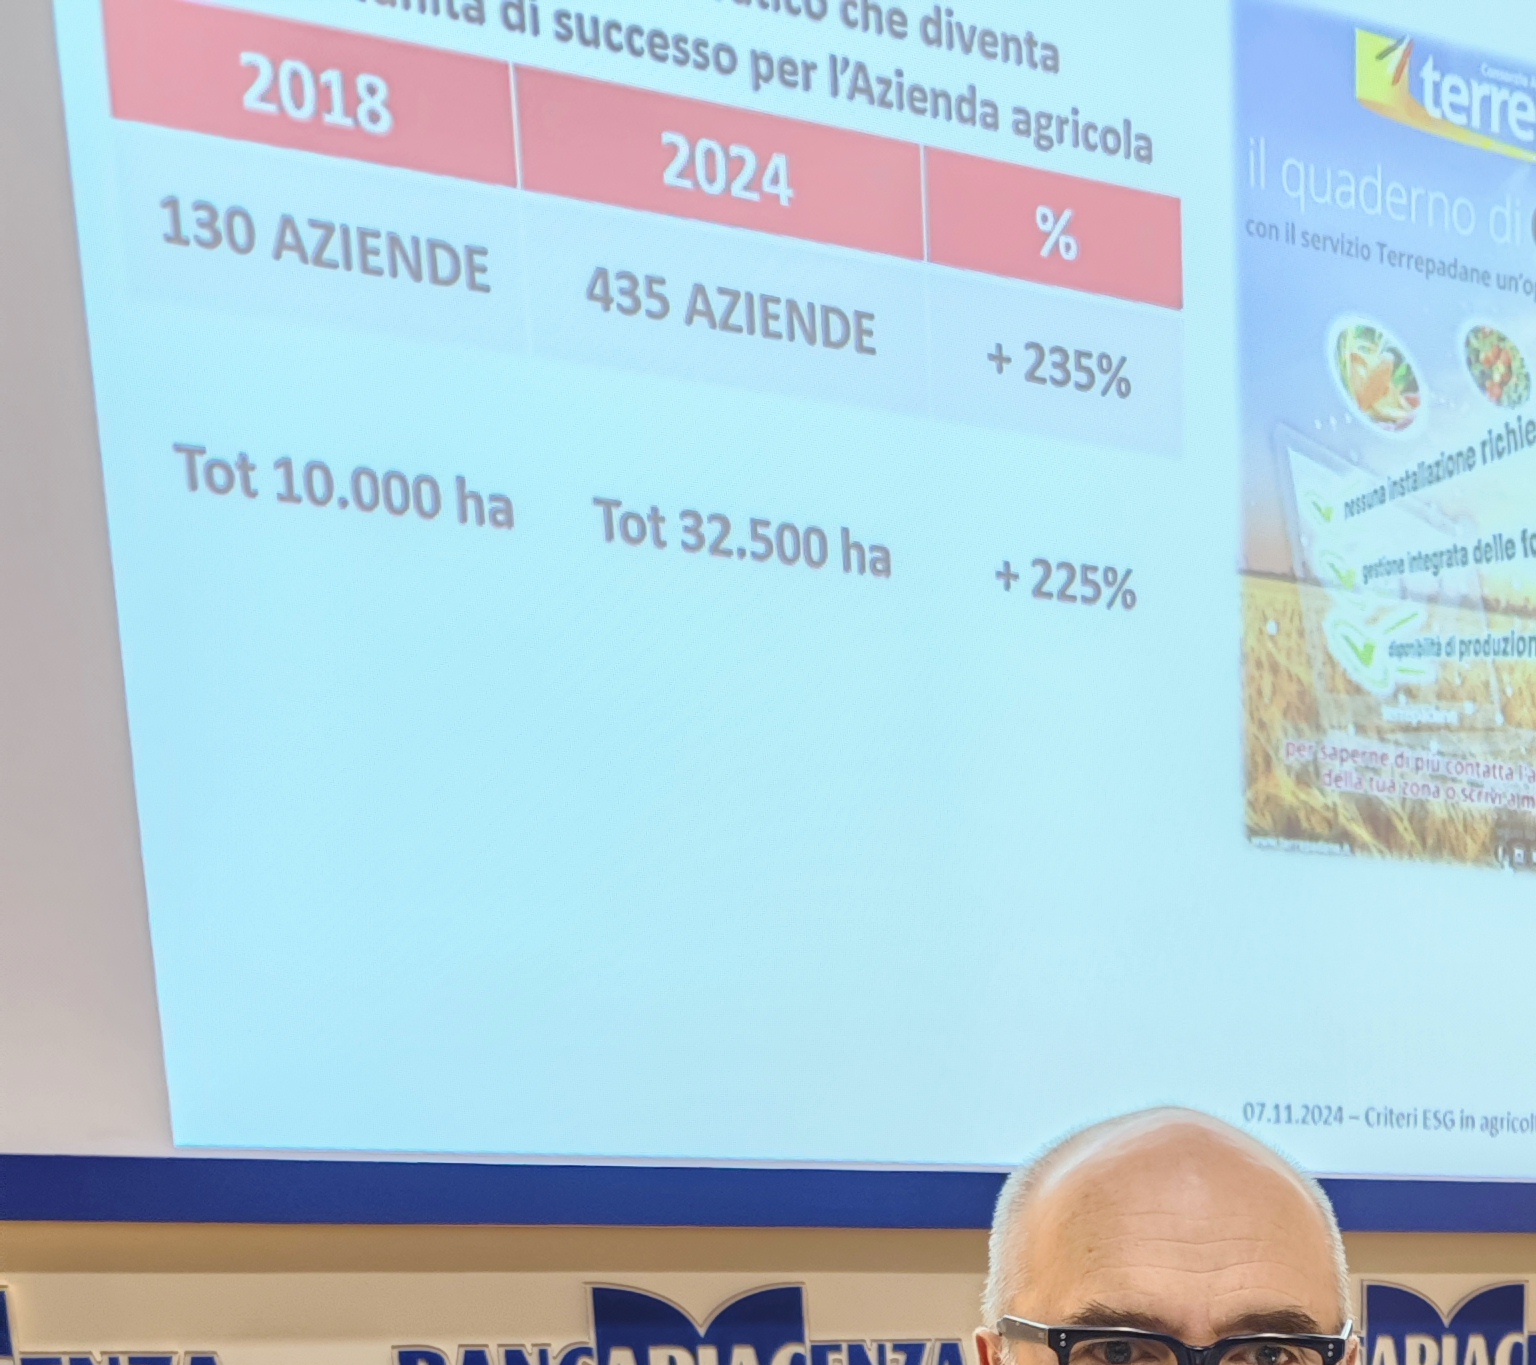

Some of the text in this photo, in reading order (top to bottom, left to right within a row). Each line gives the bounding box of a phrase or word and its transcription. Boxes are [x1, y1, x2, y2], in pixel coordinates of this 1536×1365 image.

[839, 0, 1060, 75] che diventa
[501, 0, 542, 36] di
[552, 8, 739, 76] successo
[749, 48, 818, 93] per
[828, 52, 1001, 131] l'Azienda
[1010, 106, 1154, 165] agricola
[239, 51, 1079, 261] 2018 2024 %
[1249, 135, 1267, 191] il
[1281, 157, 1477, 237] quaderno
[1488, 194, 1523, 247] di
[1246, 217, 1280, 243] con
[1284, 221, 1297, 246] il
[1301, 228, 1371, 262] servizio
[1376, 241, 1492, 288] Terrepadane
[158, 195, 257, 256] 130
[271, 212, 491, 294] AZIENDE
[584, 265, 671, 321] 435
[684, 281, 878, 356] AZIENDE
[1022, 341, 1132, 399] 235%
[1387, 445, 1477, 501] installazione
[172, 442, 258, 499] Tot
[273, 455, 443, 520] 10.000
[455, 474, 516, 531] ha
[593, 496, 667, 551] Tot
[678, 508, 829, 571] 32.500
[840, 526, 892, 579] ha
[1030, 557, 1138, 610] 225%
[1407, 543, 1469, 577] integrata
[1472, 533, 1516, 566] delle
[1284, 740, 1315, 761] per
[1320, 742, 1390, 767] saperne
[1444, 757, 1514, 783] contatta
[1322, 769, 1365, 791] della
[1401, 781, 1441, 800] zona
[1242, 1102, 1344, 1128] 07.11.2024
[1364, 1105, 1418, 1130] Criteri
[1422, 1109, 1456, 1133] ESG
[1459, 1109, 1477, 1133] in
